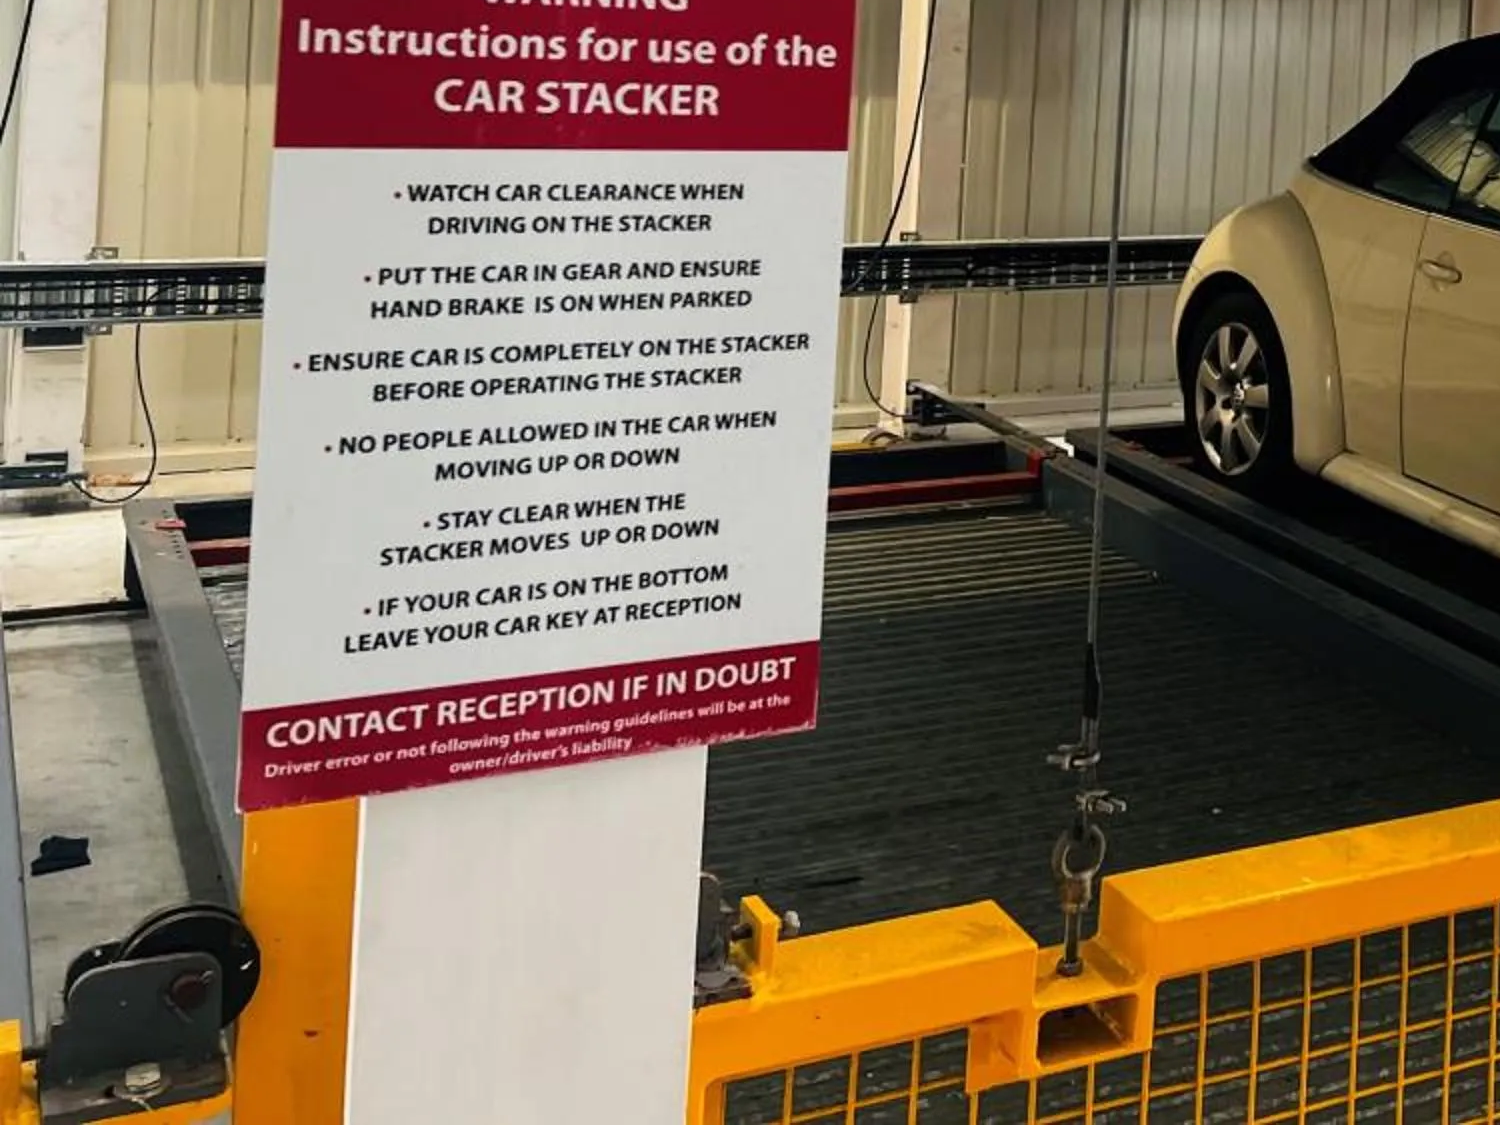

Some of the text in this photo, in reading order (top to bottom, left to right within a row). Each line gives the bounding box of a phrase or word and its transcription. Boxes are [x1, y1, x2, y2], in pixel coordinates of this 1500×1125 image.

[299, 19, 837, 67] Instructions for use of the
[435, 79, 719, 115] CAR STACKER
[408, 184, 744, 201] WATCH CAR CLEARANCE WHEN
[429, 215, 711, 234] DRIVING ON THE STACKER
[379, 260, 760, 285] PUT THE CAR IN GEAR AND ENSURE
[371, 291, 752, 318] HAND BRAKE IS ON WHEN PARKED
[309, 334, 809, 371] ENSURE CAR IS COMPLETELY ON THE STACKER
[373, 367, 741, 402] BEFORE OPERATING THE STACKER
[339, 411, 776, 455] NO PEOPLE ALLOWED IN THE CAR WHEN
[436, 448, 679, 481] MOVING UP OR DOWN
[438, 493, 685, 530] STAY CLEAR WHEN THE
[381, 519, 719, 566] STACKER MOVES UP OR DOWN
[379, 565, 728, 616] IF YOUR CAR IS ON THE BOTTOM
[345, 593, 741, 653] LEAVE YOUR CAR KEY AT RECEPTION
[267, 657, 796, 747] CONTACT RECEPTION IF IN DOUBT
[265, 695, 790, 777] Driver error or not following the warning guidelines will be at the
[450, 737, 632, 773] owner/driver's liability
